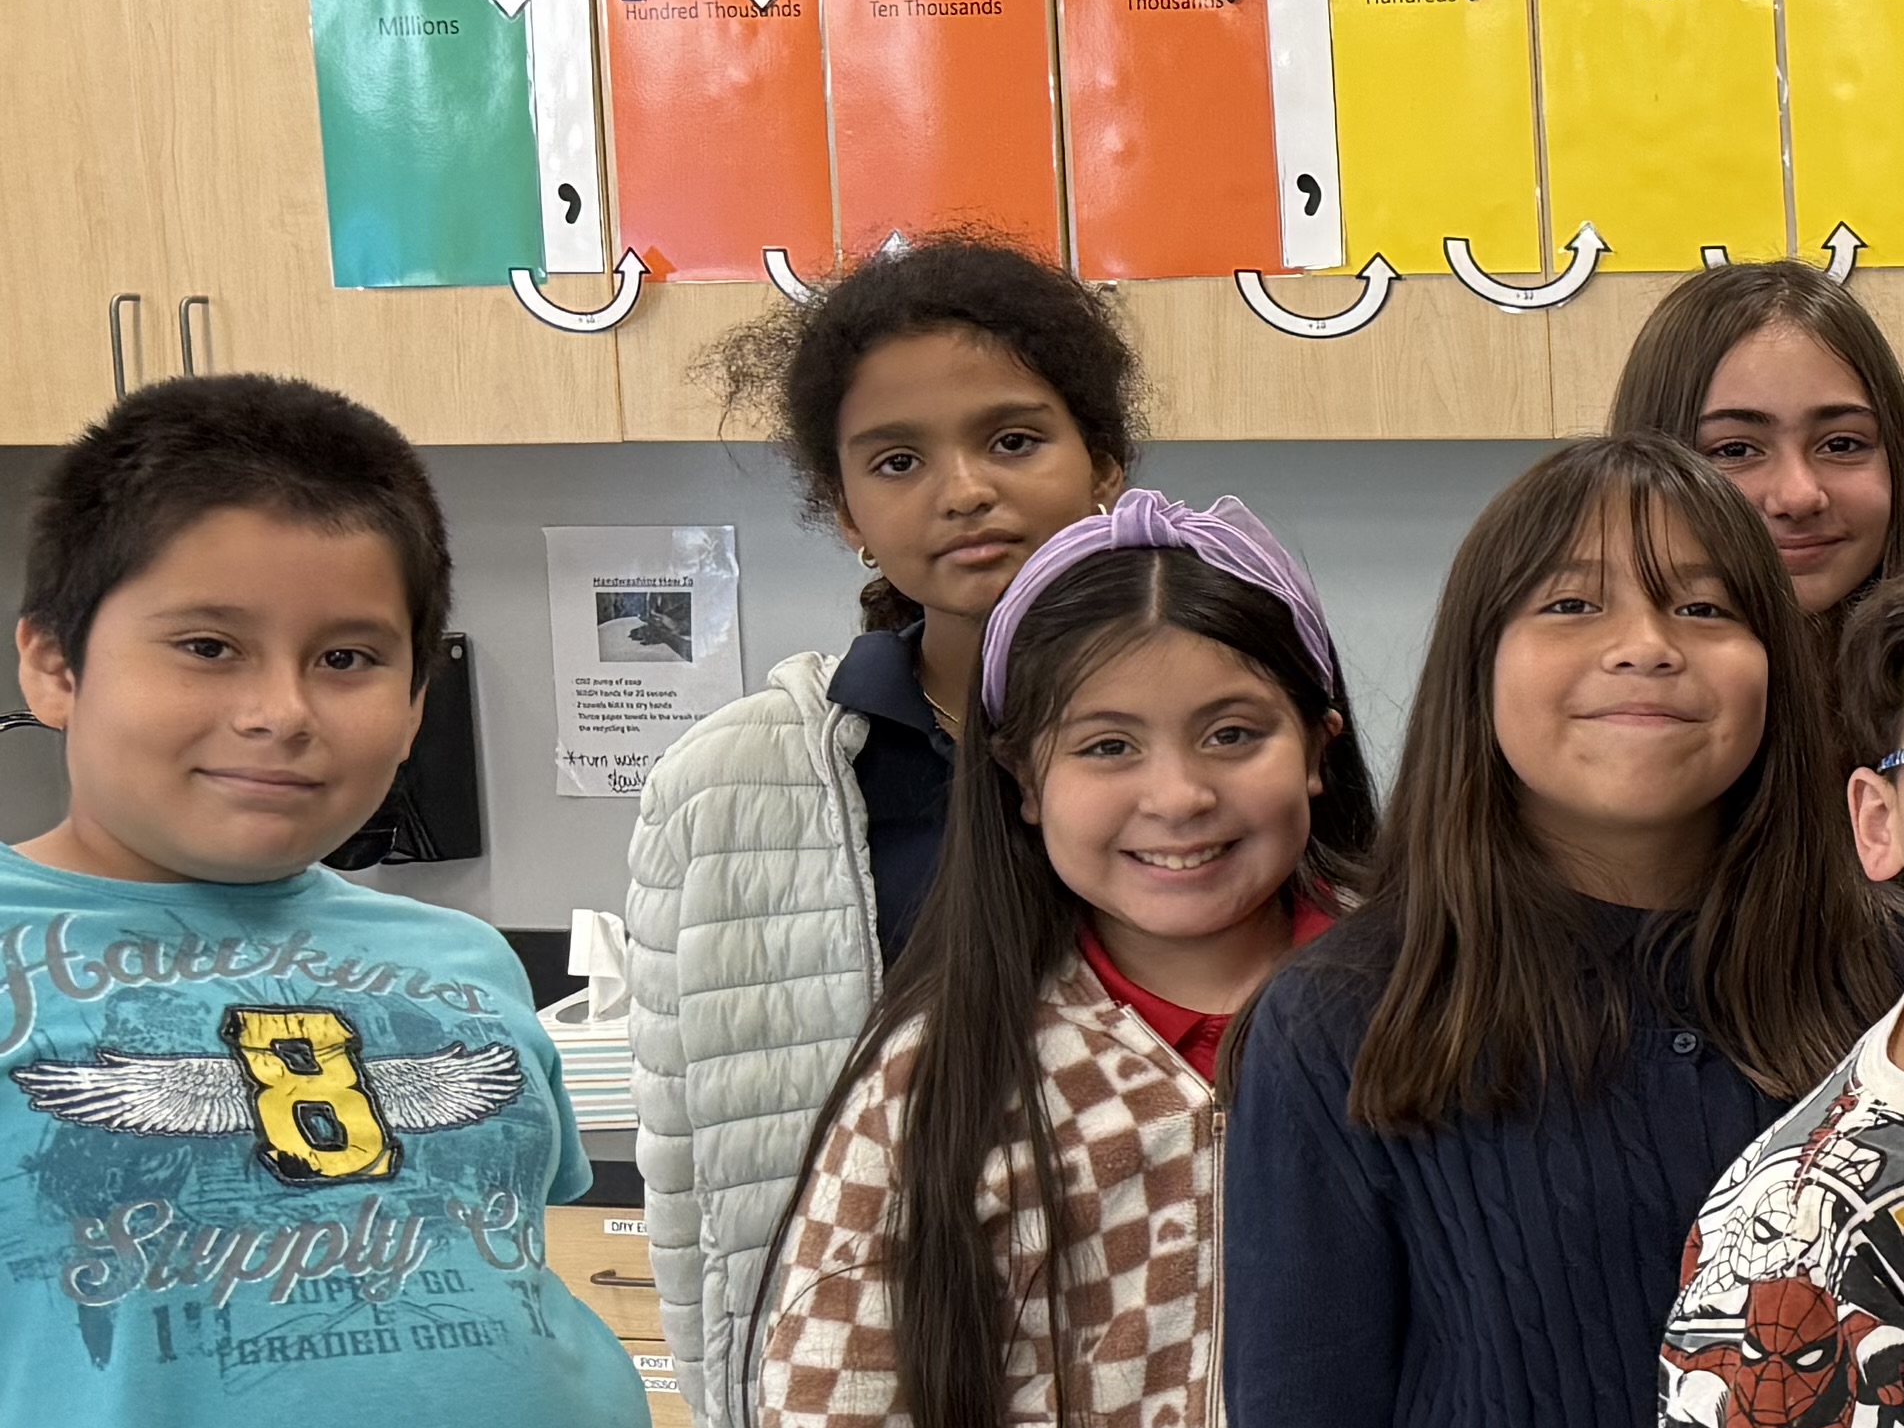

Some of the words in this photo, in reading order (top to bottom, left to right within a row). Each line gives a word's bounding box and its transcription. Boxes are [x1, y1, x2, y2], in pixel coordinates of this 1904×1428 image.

[624, 0, 699, 22] Hundred
[378, 14, 461, 38] Millions
[220, 1004, 403, 1186] 8
